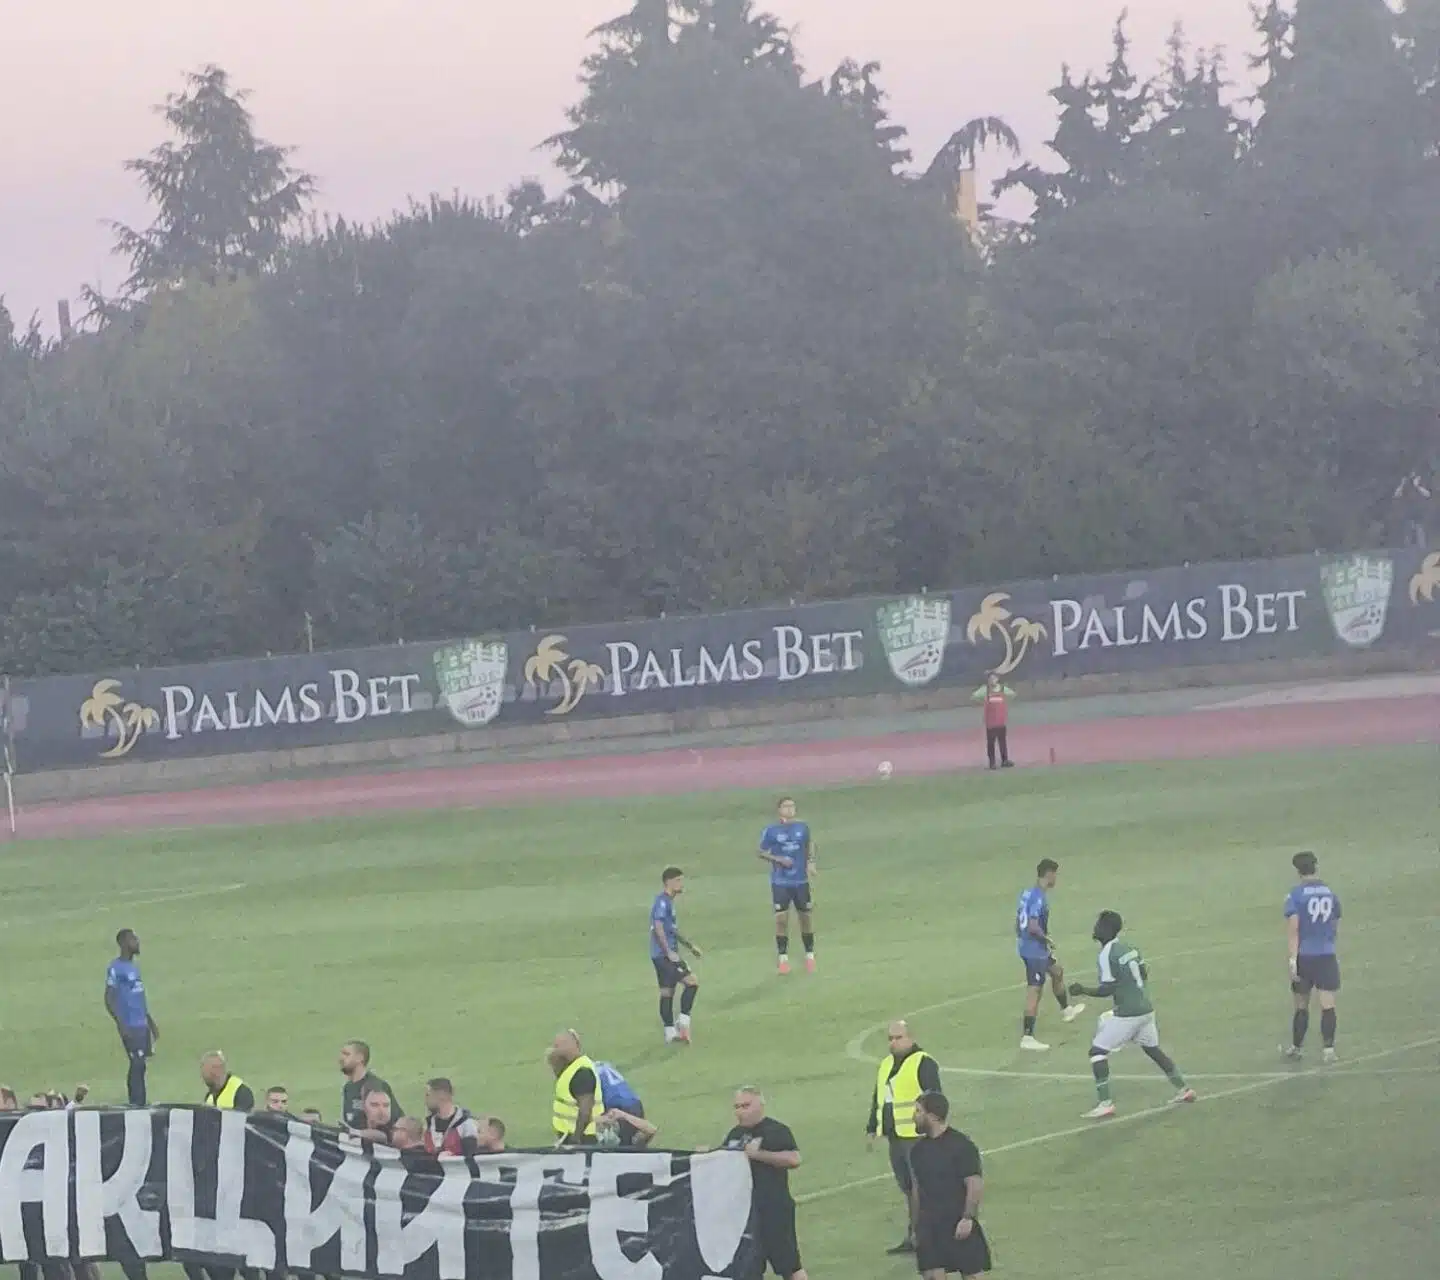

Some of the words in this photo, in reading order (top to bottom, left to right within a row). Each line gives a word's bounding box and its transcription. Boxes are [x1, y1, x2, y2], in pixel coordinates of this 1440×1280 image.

[1050, 597, 1207, 656] PALMS
[1217, 584, 1306, 641] BET
[606, 640, 762, 696] PALMS
[774, 626, 863, 681] BET
[161, 682, 322, 739] PALMS
[329, 669, 420, 722] BET
[1307, 896, 1333, 923] 99
